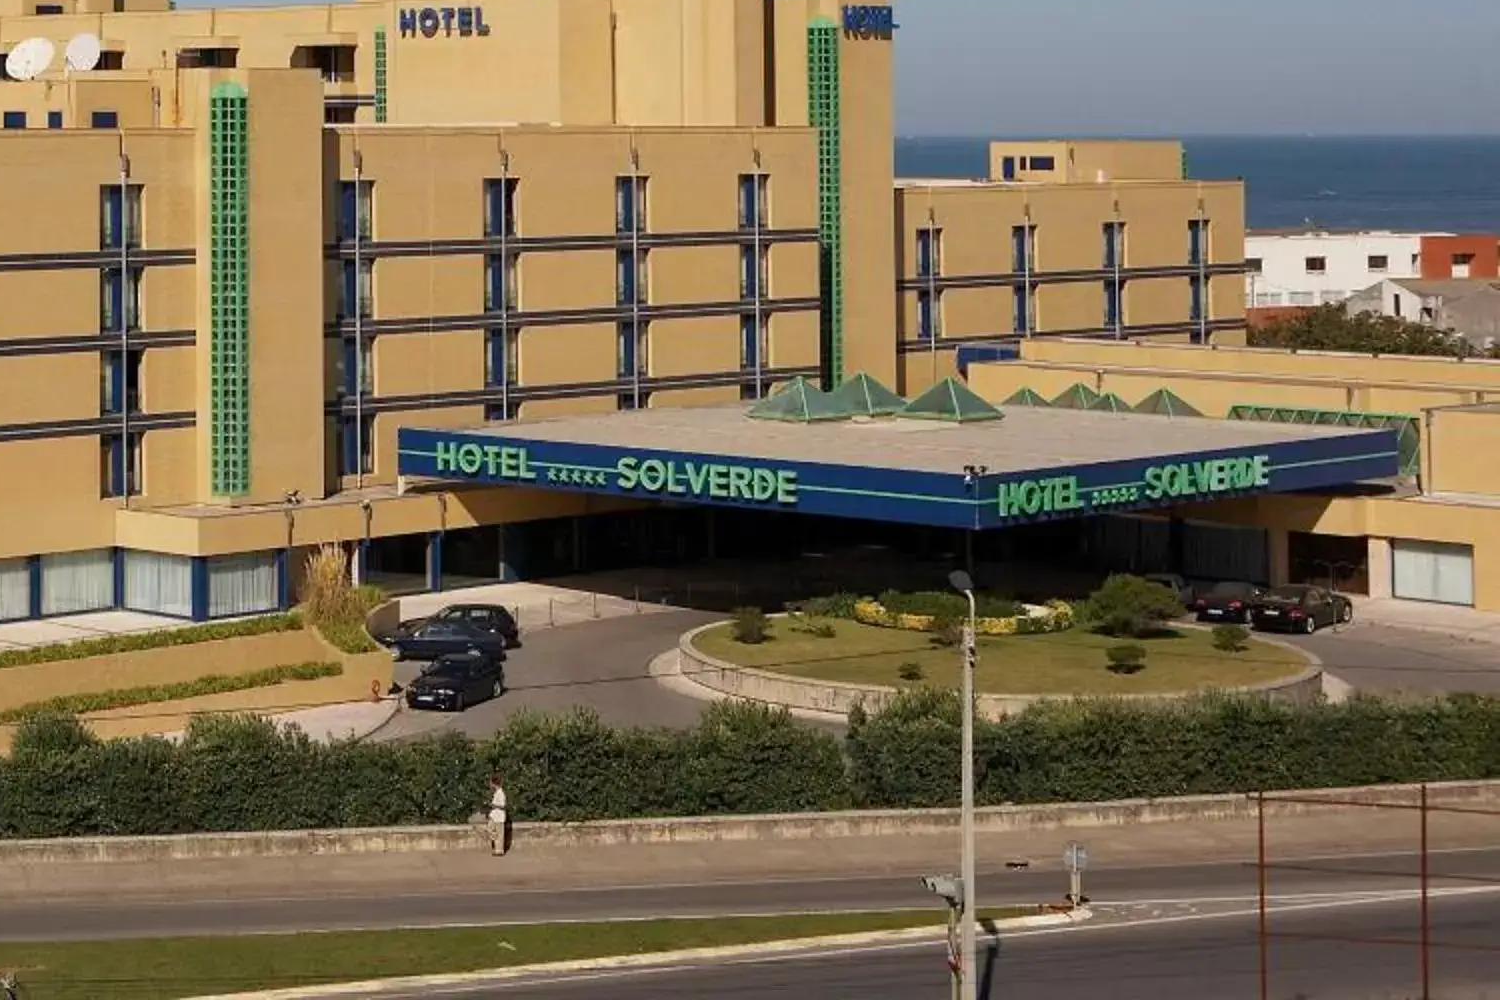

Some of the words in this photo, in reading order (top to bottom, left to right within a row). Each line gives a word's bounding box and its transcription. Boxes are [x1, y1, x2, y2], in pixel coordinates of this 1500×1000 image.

[399, 6, 490, 37] HOTEL
[435, 441, 536, 479] HOTEL
[616, 456, 799, 503] SOLVERDE
[999, 475, 1084, 517] HOTEL
[1145, 454, 1270, 499] SOLVERDE
